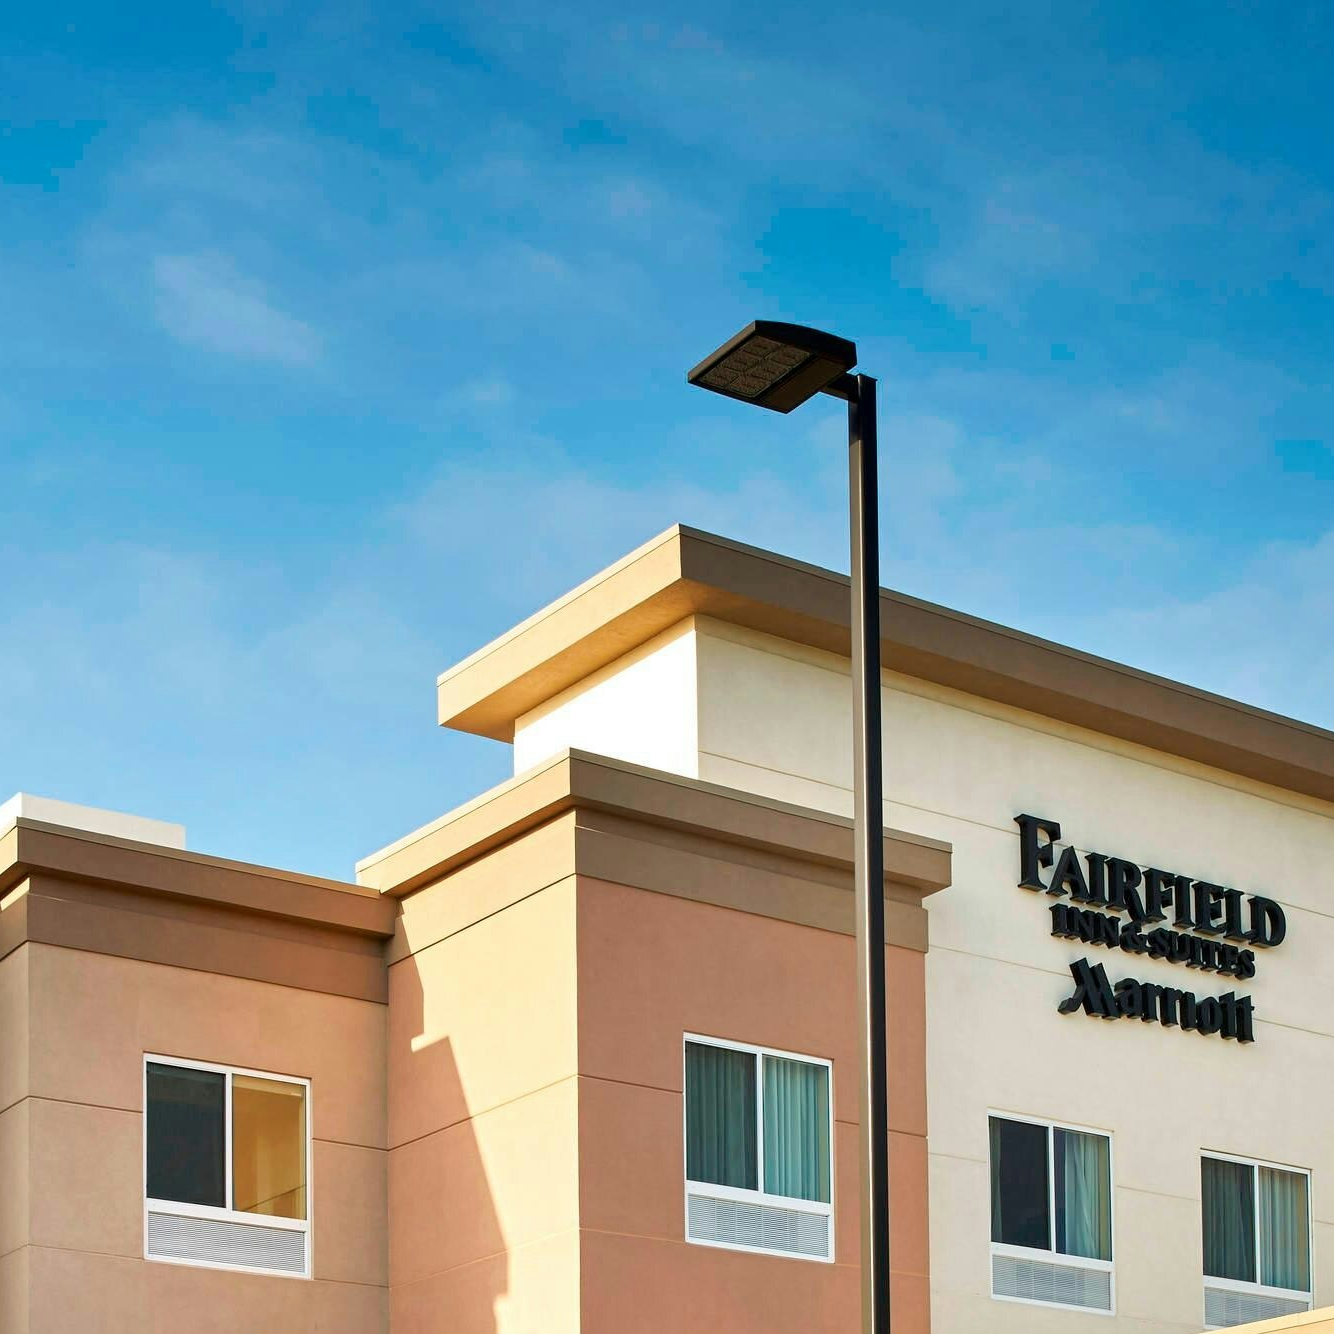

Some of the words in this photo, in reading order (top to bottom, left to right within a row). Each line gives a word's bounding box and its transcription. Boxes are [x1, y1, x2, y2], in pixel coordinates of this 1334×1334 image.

[1013, 814, 1286, 948] FAIRFIELD
[1049, 903, 1121, 949] INN
[1120, 919, 1150, 955] &
[1147, 928, 1256, 980] SUITES
[1057, 957, 1255, 1044] Marriott
